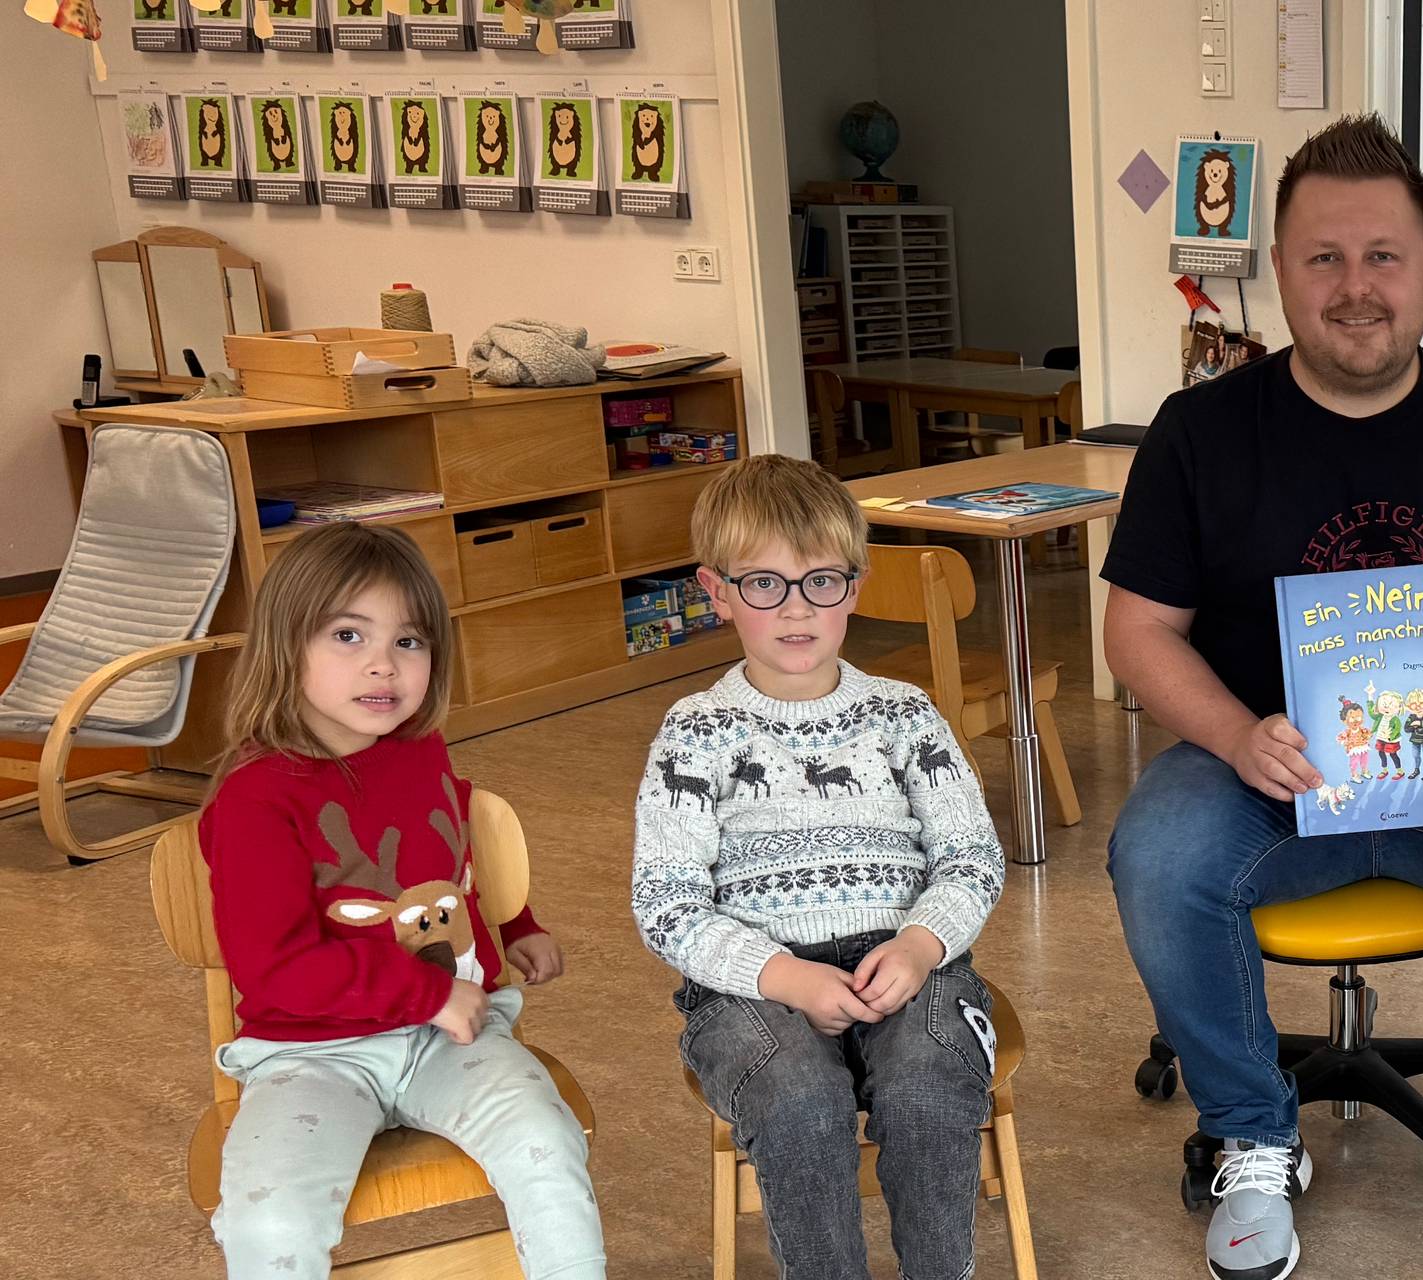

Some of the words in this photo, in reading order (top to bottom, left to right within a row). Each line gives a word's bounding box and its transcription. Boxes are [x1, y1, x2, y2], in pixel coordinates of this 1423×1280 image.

[1303, 601, 1342, 627] Ein
[1299, 634, 1345, 657] muss
[1337, 647, 1386, 673] sein!
